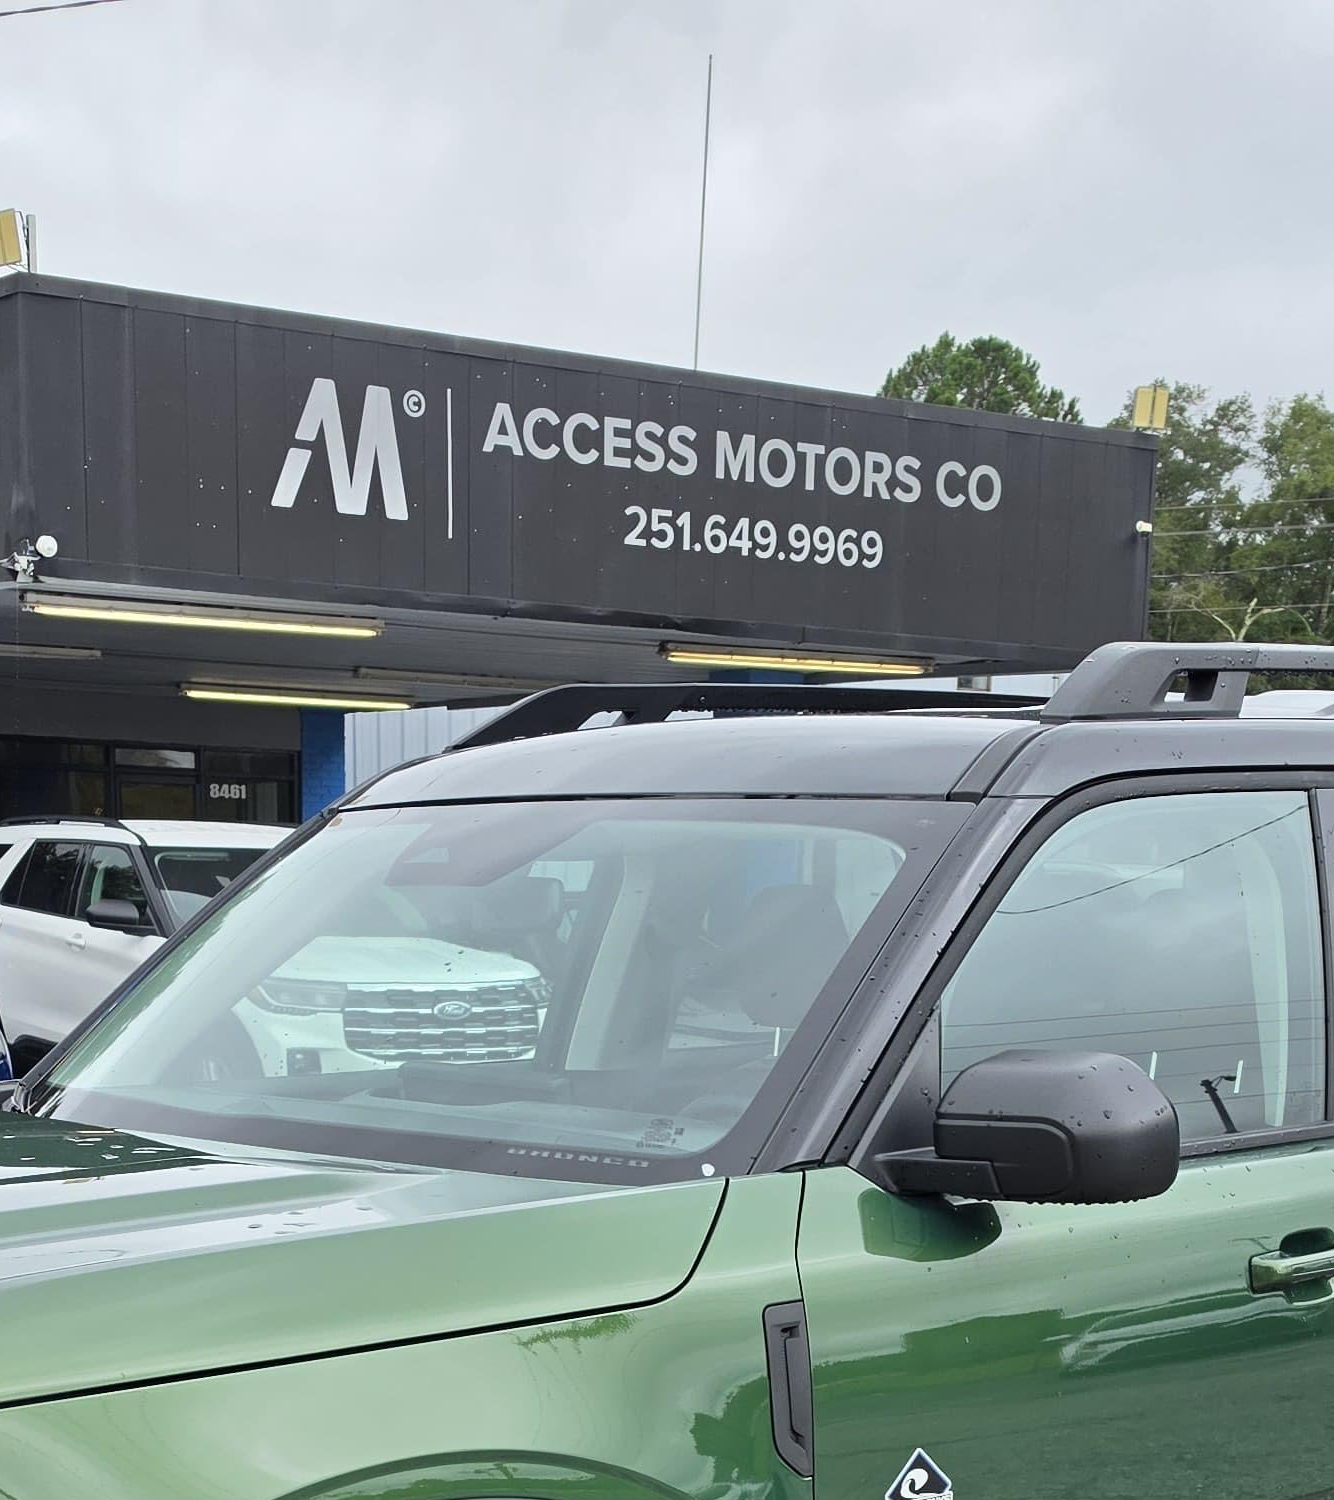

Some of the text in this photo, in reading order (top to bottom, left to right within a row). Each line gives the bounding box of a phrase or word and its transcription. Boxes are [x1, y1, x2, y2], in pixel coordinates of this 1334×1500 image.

[482, 402, 1003, 512] ACCESS MOTORS CO
[623, 505, 884, 569] 251.649.9969
[209, 783, 247, 799] 8461
